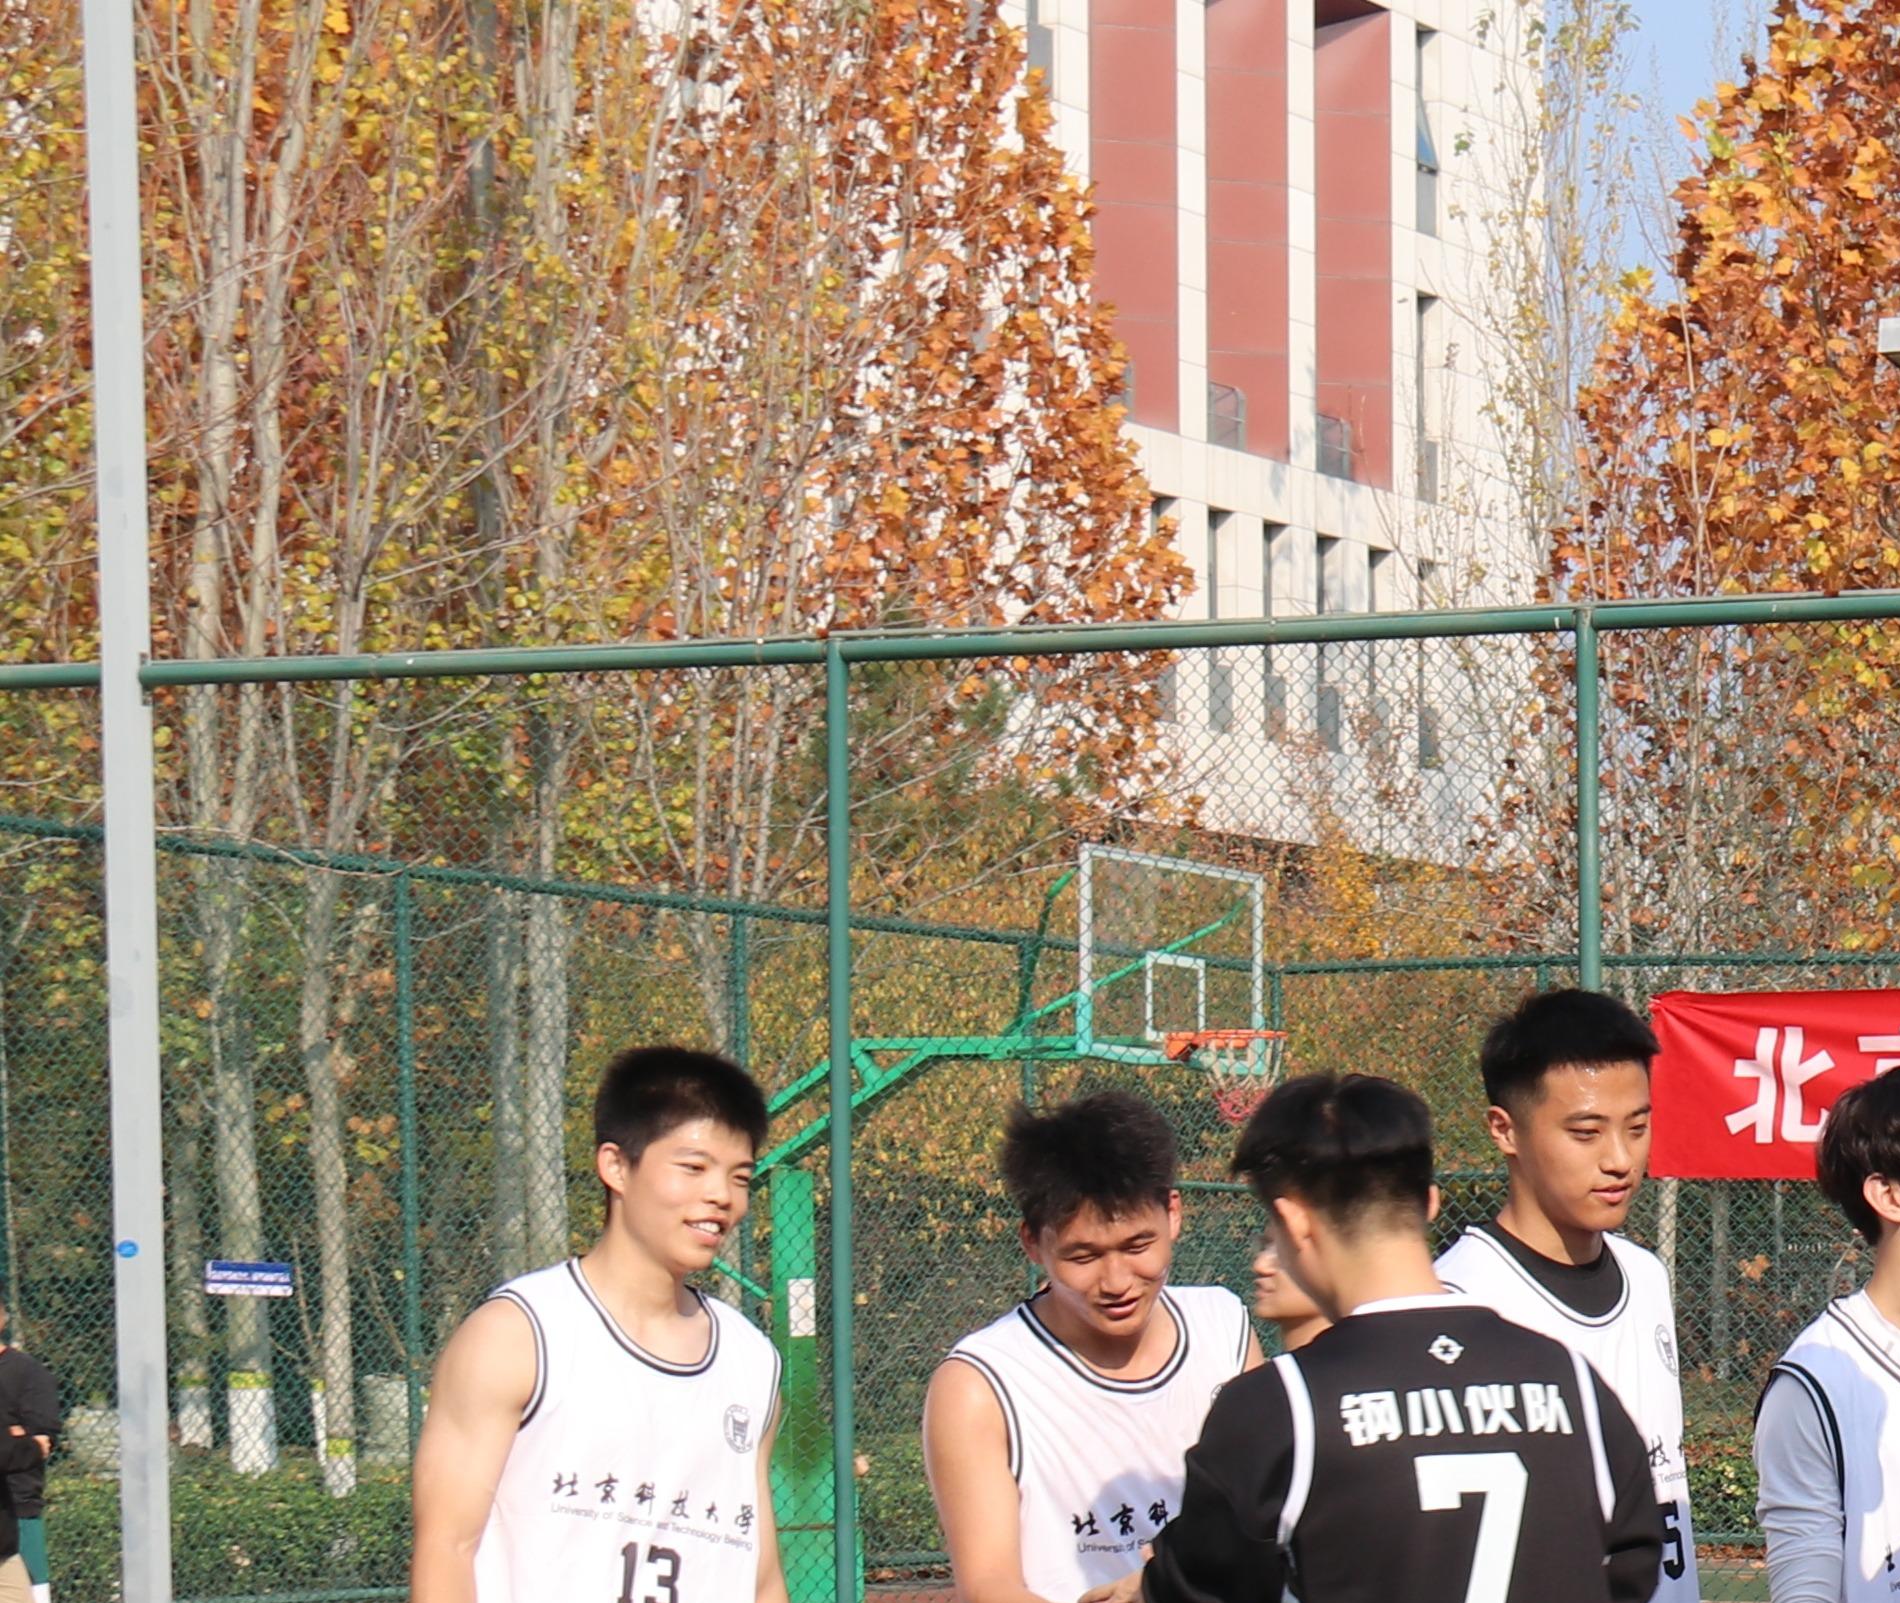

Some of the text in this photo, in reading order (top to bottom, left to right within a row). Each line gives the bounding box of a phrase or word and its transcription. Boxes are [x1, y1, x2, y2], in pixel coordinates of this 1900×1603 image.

[1340, 1383, 1574, 1447] 钢小伙队
[550, 1502, 599, 1521] University
[1071, 1497, 1170, 1537] 北京科
